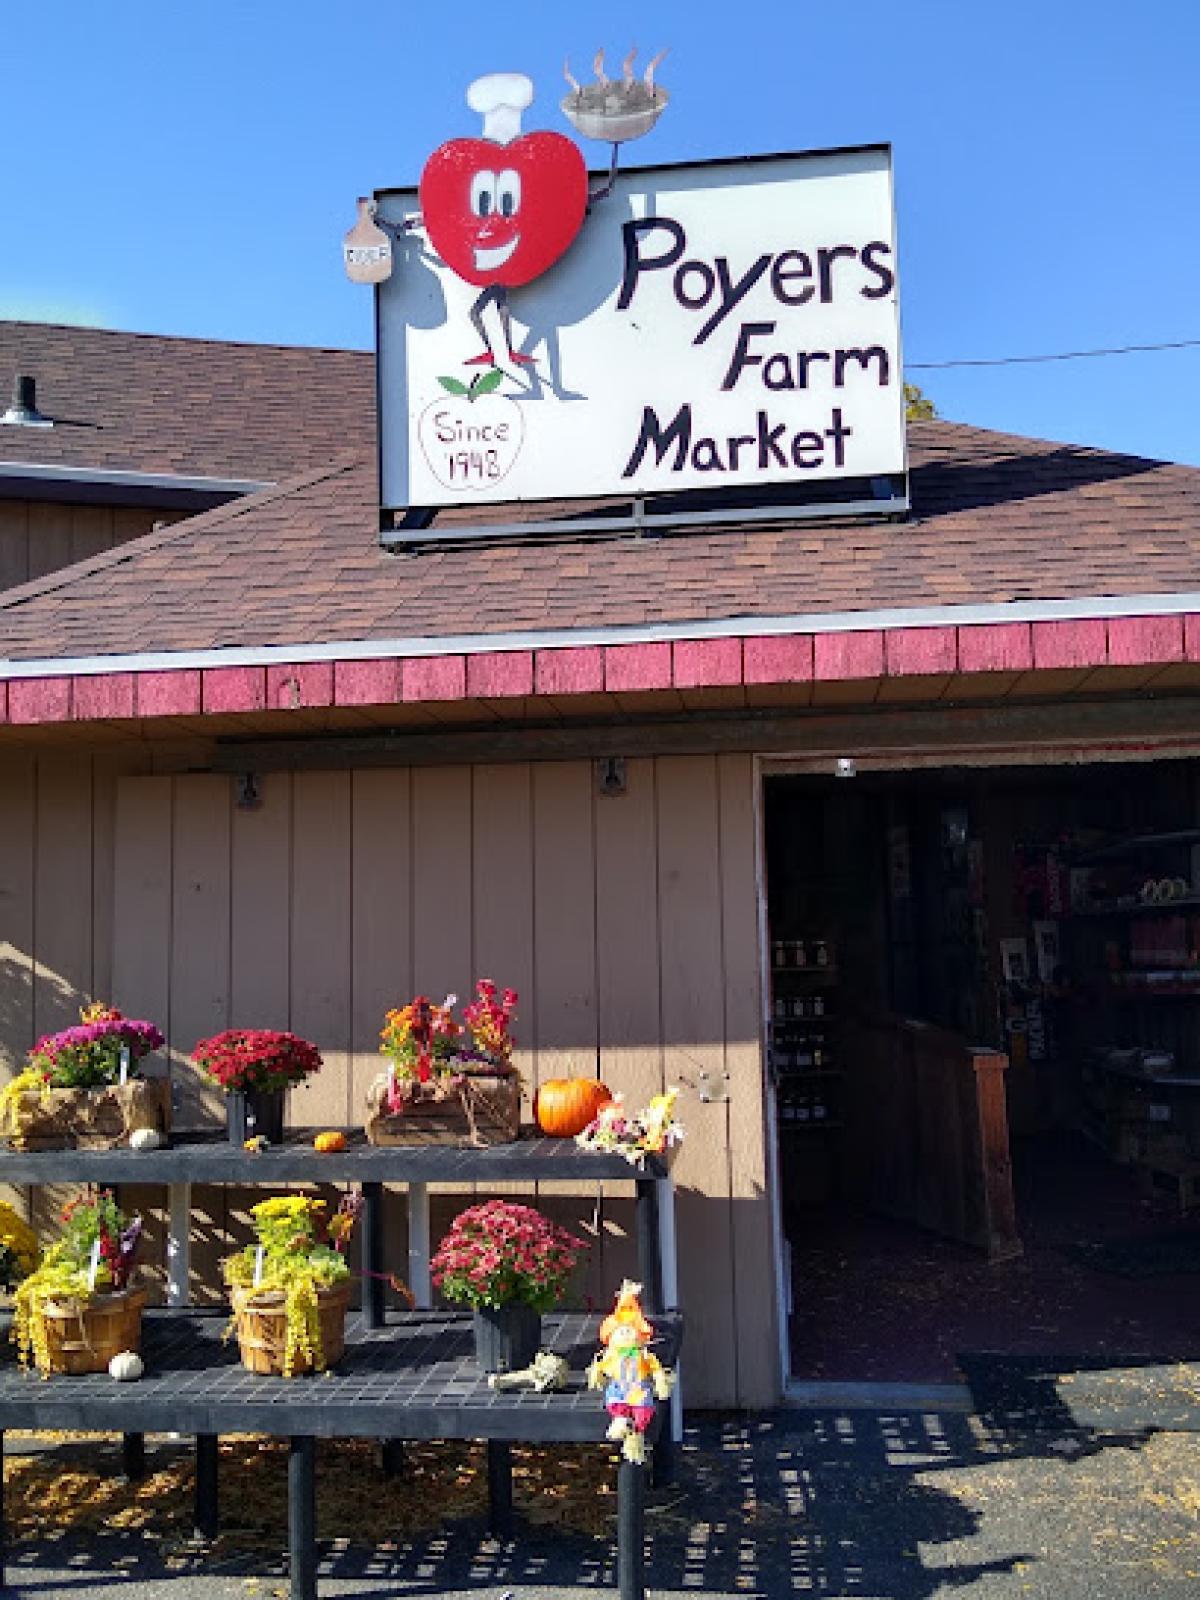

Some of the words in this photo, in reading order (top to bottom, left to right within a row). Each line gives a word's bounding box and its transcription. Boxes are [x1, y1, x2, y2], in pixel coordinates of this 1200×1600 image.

[615, 217, 894, 346] Poyers
[719, 319, 889, 392] Farm
[434, 411, 509, 443] Since
[620, 403, 852, 479] Market
[444, 449, 500, 481] 1948
